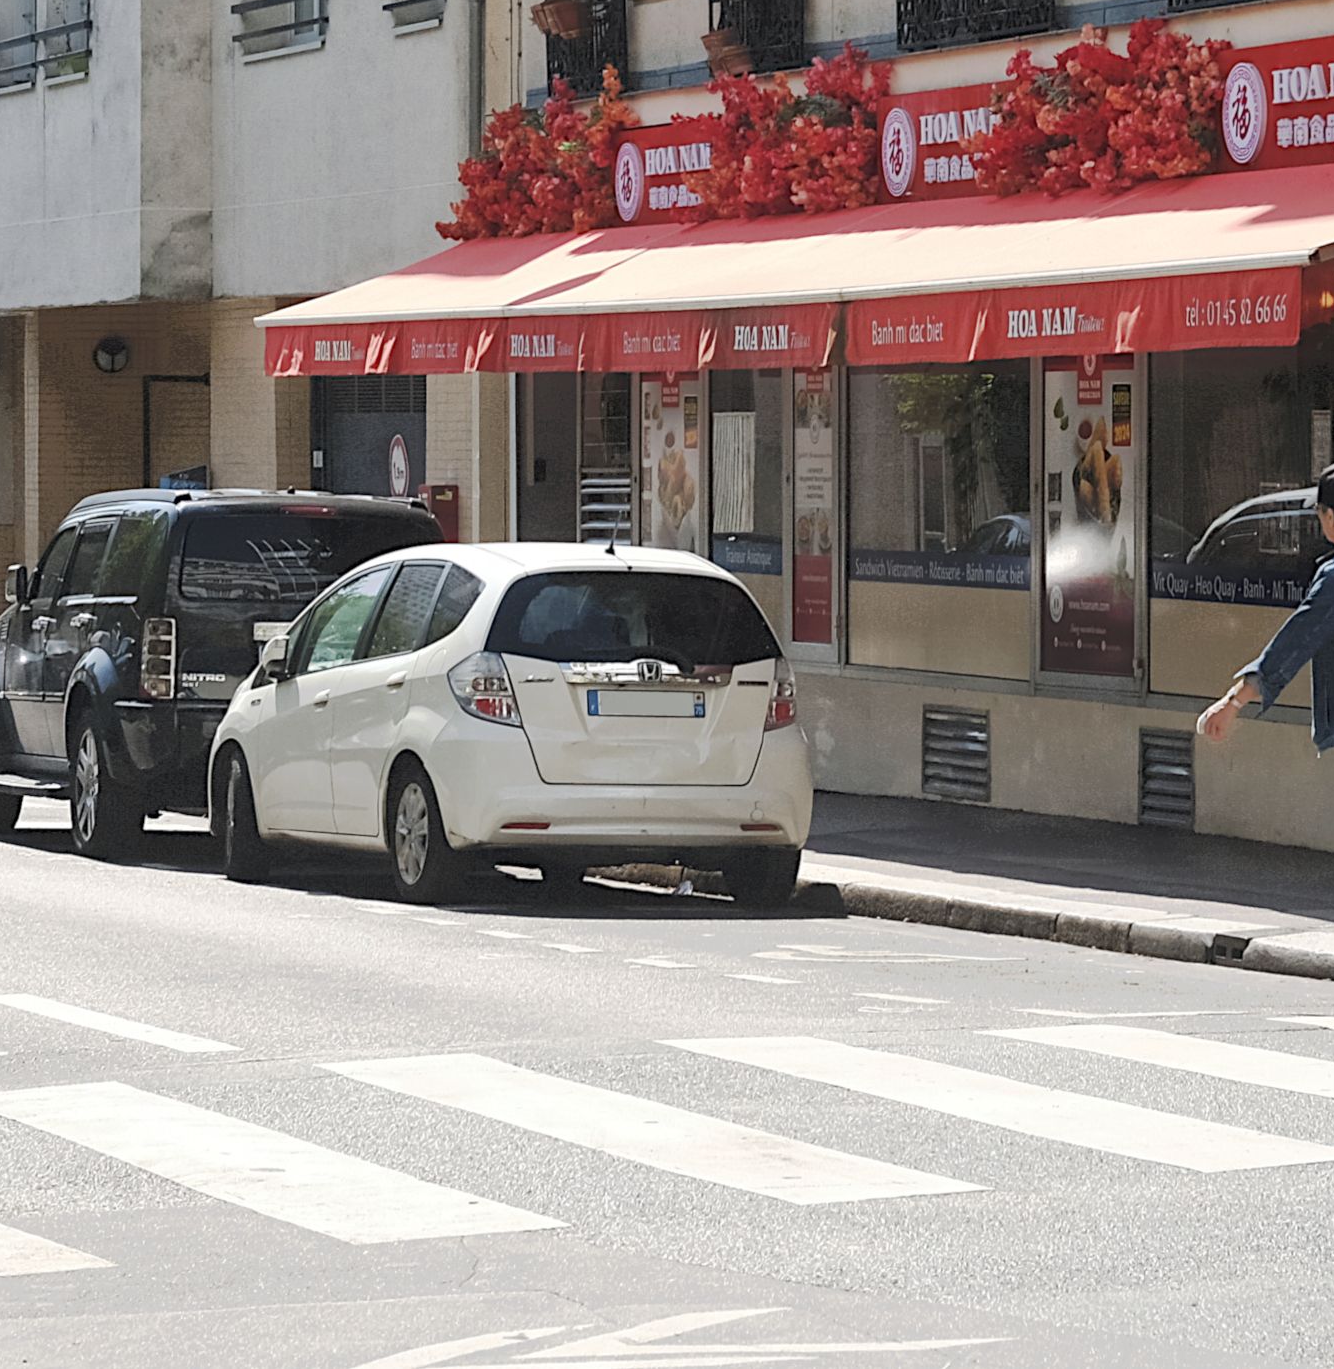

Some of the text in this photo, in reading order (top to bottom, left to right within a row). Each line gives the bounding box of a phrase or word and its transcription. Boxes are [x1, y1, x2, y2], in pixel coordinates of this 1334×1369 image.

[1271, 63, 1328, 105] HOA
[919, 111, 961, 146] HOA
[645, 146, 678, 177] HOA
[1007, 310, 1038, 340] HOA
[1041, 306, 1077, 338] NAM
[1240, 297, 1252, 326] 82
[1255, 295, 1271, 324] 66
[1273, 293, 1288, 323] 66
[314, 339, 331, 362] HOA
[332, 339, 351, 362] NAM
[510, 334, 530, 358] HOA
[532, 333, 555, 358] NAM
[733, 325, 758, 352] HOA
[760, 324, 789, 351] NAM
[855, 557, 886, 578] Sandwich
[1166, 572, 1189, 600] Quay
[1194, 574, 1213, 596] Heo
[1213, 575, 1237, 602] Quay
[181, 672, 226, 683] NITRO
